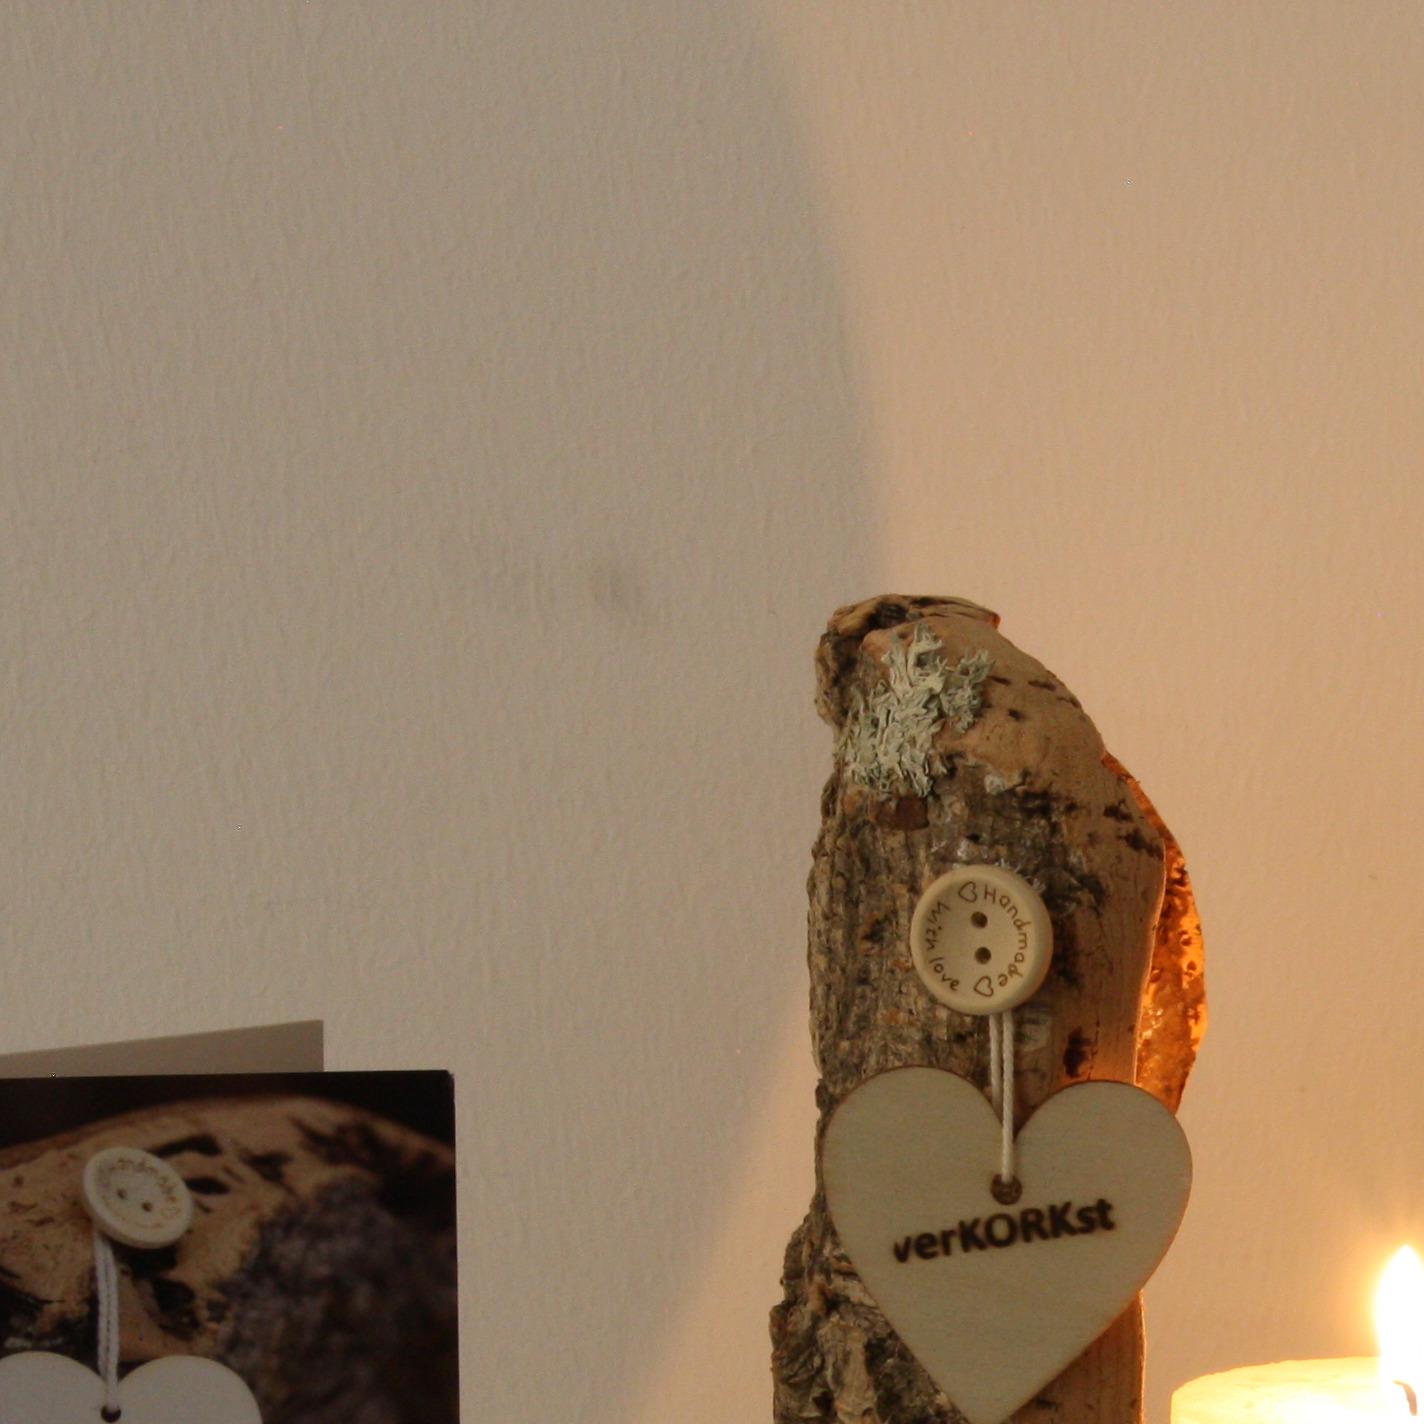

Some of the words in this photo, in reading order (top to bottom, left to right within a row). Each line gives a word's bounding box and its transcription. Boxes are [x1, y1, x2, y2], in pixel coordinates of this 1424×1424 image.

[984, 884, 1032, 987] Handmade
[928, 956, 961, 991] love
[893, 1198, 1115, 1263] verKORKst
